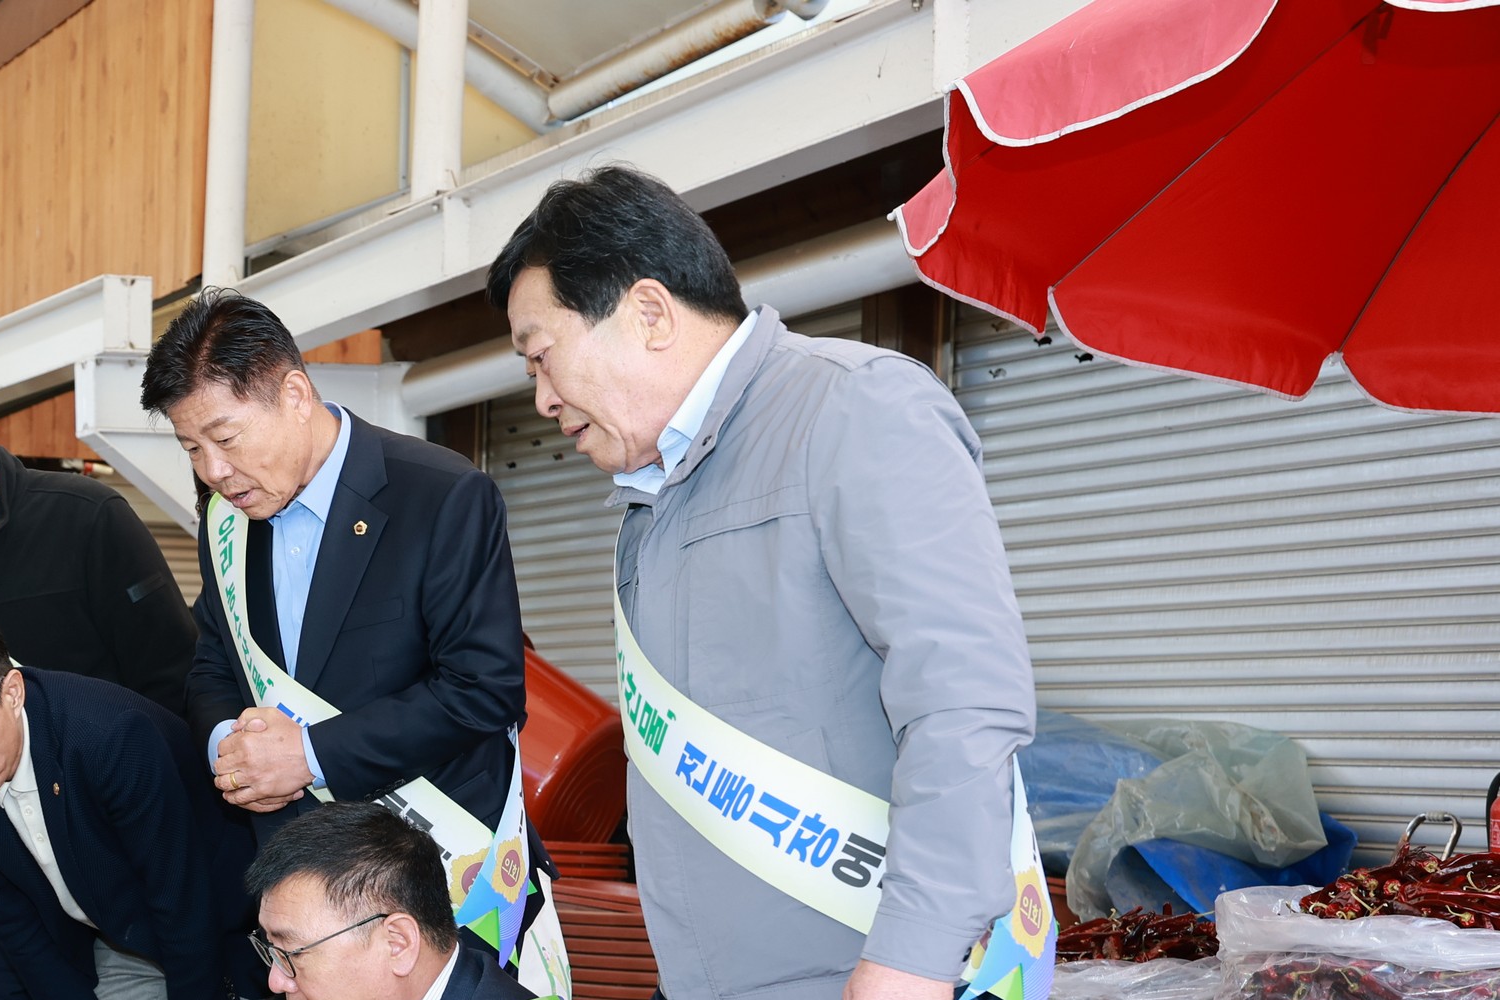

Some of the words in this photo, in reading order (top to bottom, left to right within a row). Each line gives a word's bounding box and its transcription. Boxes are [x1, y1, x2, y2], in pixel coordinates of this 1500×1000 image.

[218, 514, 236, 577] 우리
[675, 741, 888, 889] 전통시장에
[500, 857, 520, 882] 의회
[1019, 896, 1042, 929] 의회
